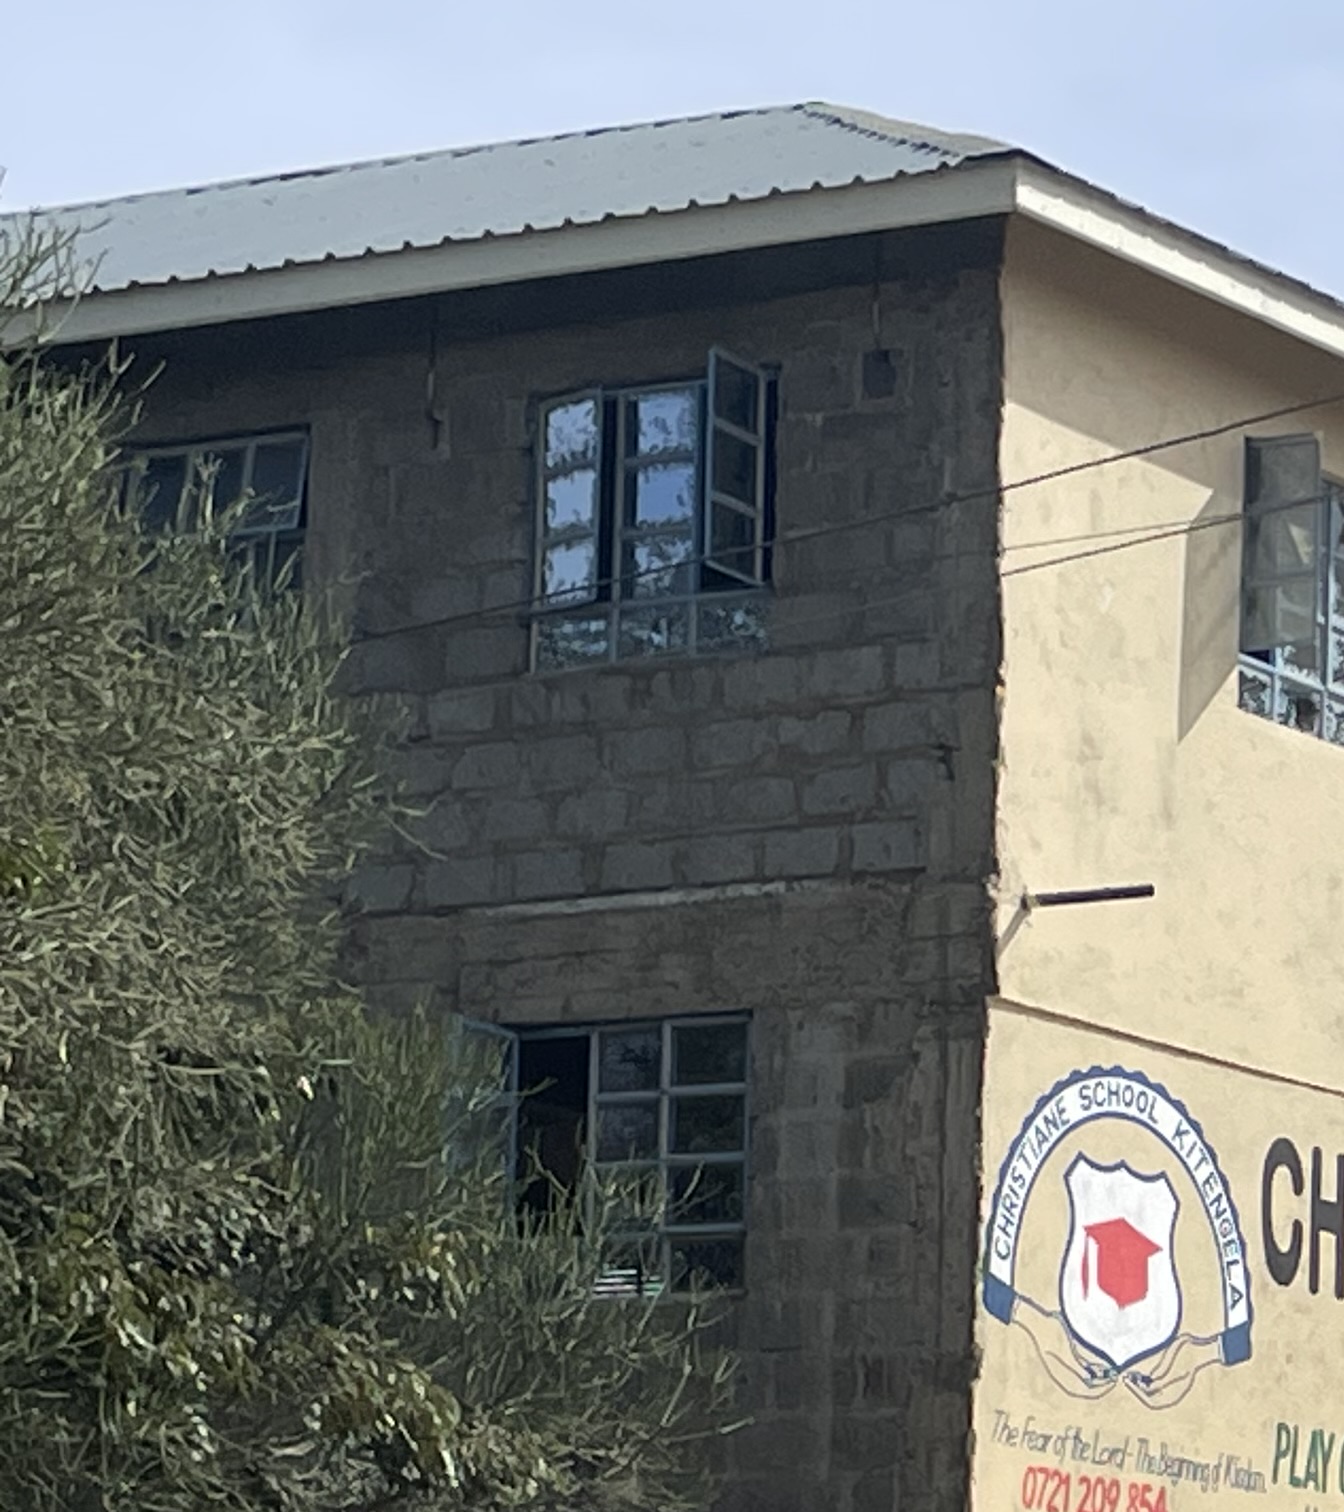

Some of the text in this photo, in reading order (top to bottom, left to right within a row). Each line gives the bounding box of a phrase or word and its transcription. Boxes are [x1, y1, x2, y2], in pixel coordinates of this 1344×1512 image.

[994, 1080, 1243, 1312] CHRISTIANE SCHOOL KITENGELA
[991, 1408, 1019, 1447] The
[1020, 1415, 1053, 1453] Fear
[1052, 1424, 1073, 1466] of
[1272, 1423, 1335, 1494] PLAY
